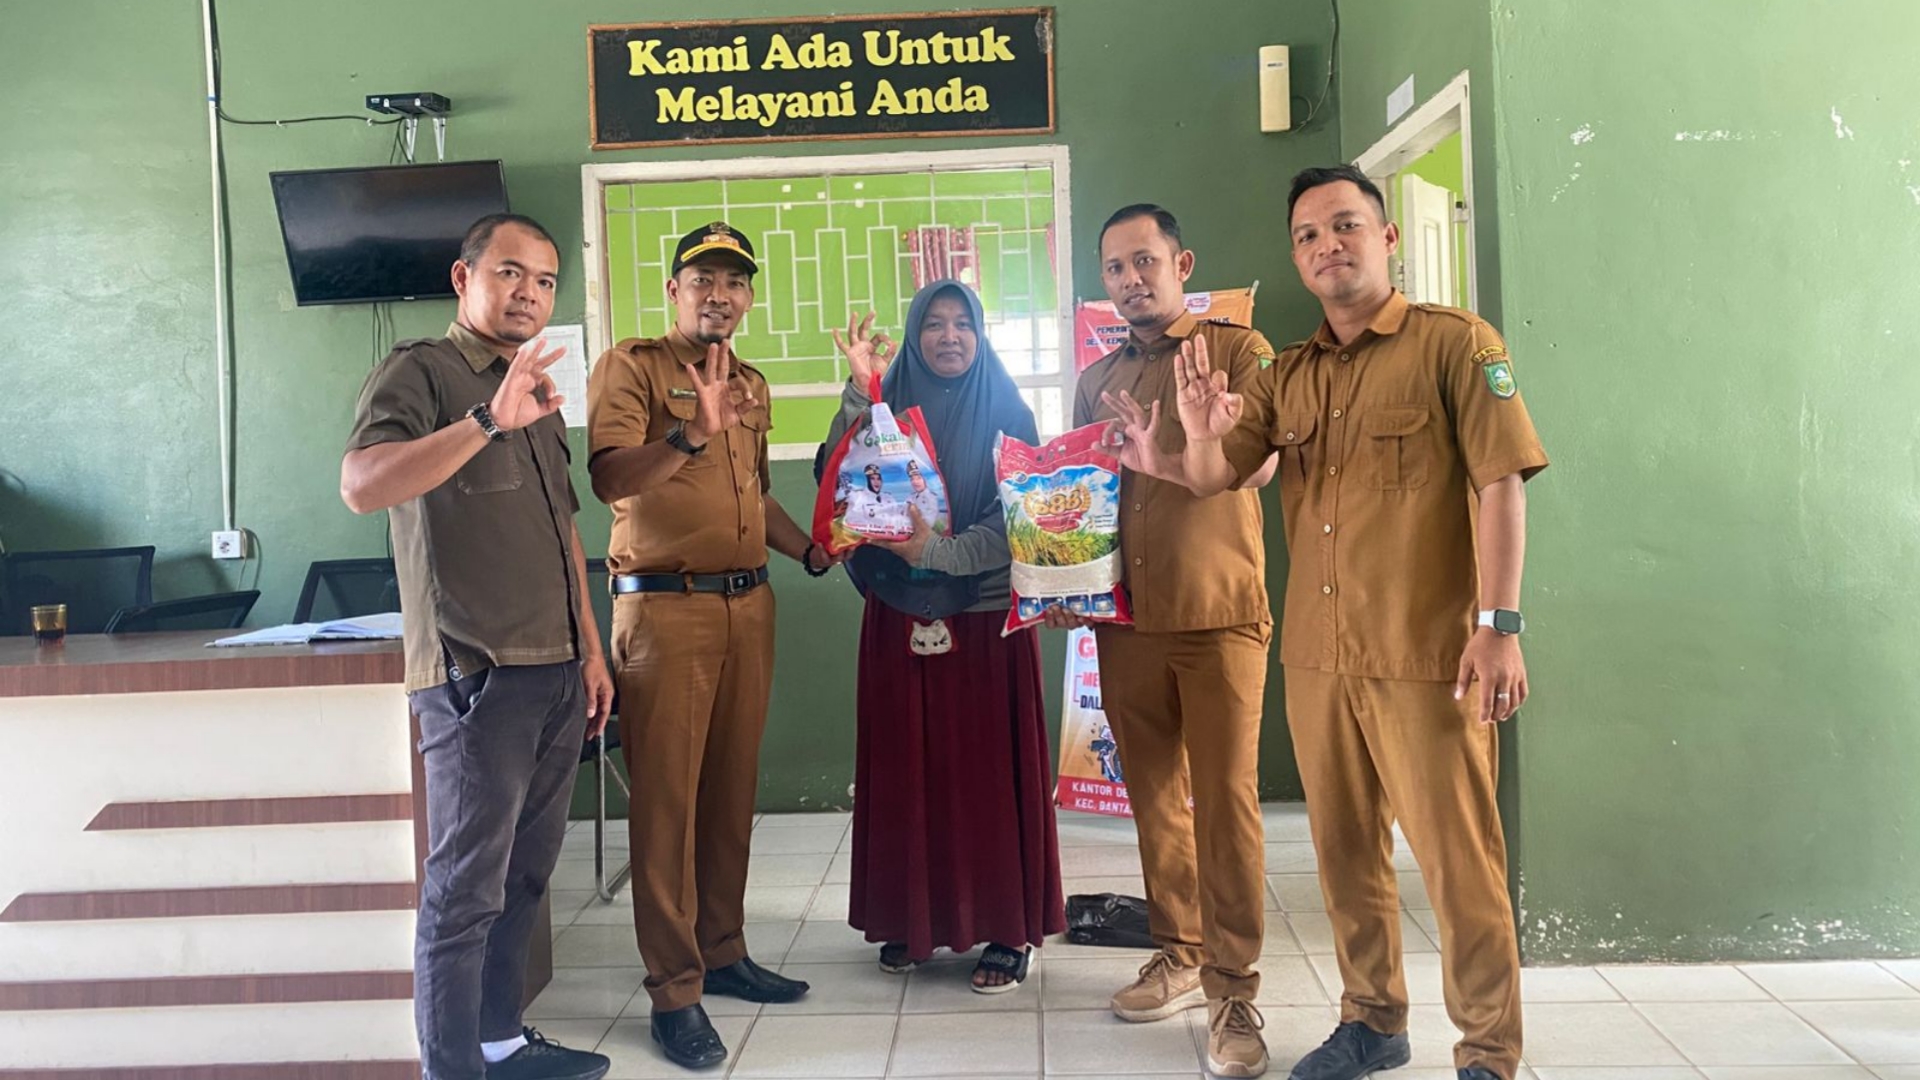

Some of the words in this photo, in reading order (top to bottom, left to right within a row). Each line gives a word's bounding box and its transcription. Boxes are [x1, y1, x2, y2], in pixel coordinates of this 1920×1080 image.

[627, 35, 751, 77] Kami
[761, 33, 853, 70] Ada
[862, 26, 1016, 67] Untuk
[655, 81, 856, 128] Melayani
[867, 77, 989, 115] Anda
[1096, 325, 1131, 335] PEMERIN
[1082, 672, 1100, 688] ME
[1080, 695, 1104, 710] DAL
[1072, 781, 1112, 797] KANTOR
[1116, 787, 1129, 799] DE
[1099, 801, 1133, 815] BANTA
